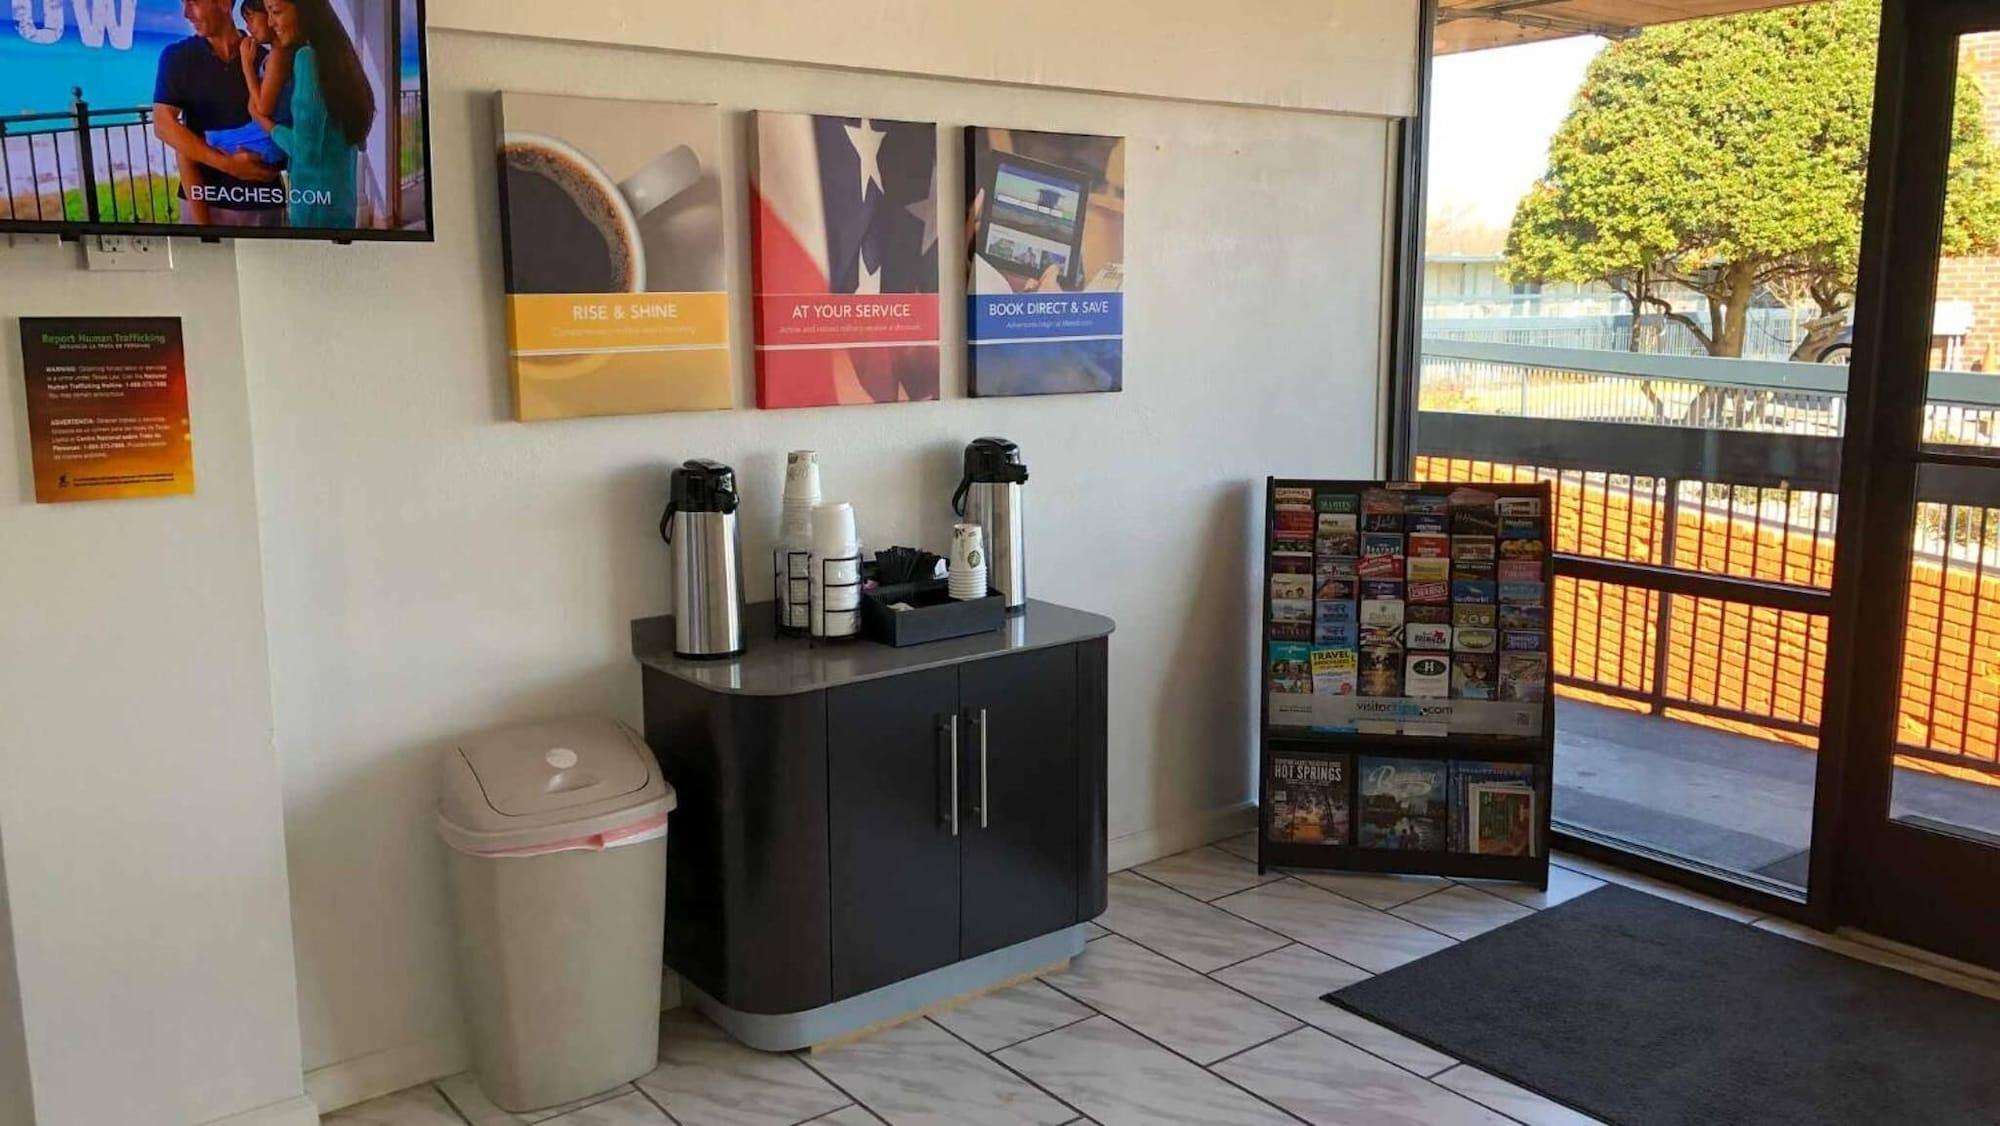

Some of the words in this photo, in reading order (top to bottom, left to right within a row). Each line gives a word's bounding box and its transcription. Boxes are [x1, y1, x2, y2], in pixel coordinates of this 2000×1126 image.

[190, 185, 332, 206] BEACHES.COM
[572, 304, 608, 320] RISE
[613, 305, 626, 319] &
[630, 303, 678, 319] SHINE
[792, 304, 810, 319] AT
[814, 304, 851, 318] YOUR
[856, 303, 911, 317] SERVICE
[989, 303, 1024, 316] BOOK
[1027, 302, 1067, 315] DIRECT
[1070, 302, 1079, 314] &
[1082, 301, 1109, 313] SAVE
[42, 334, 75, 346] Report
[78, 334, 112, 344] Human
[113, 333, 166, 345] Trafficking
[1312, 650, 1350, 661] TRAVEL
[1424, 661, 1434, 672] H
[1275, 763, 1295, 779] HOT
[1296, 764, 1342, 782] SPRINGS
